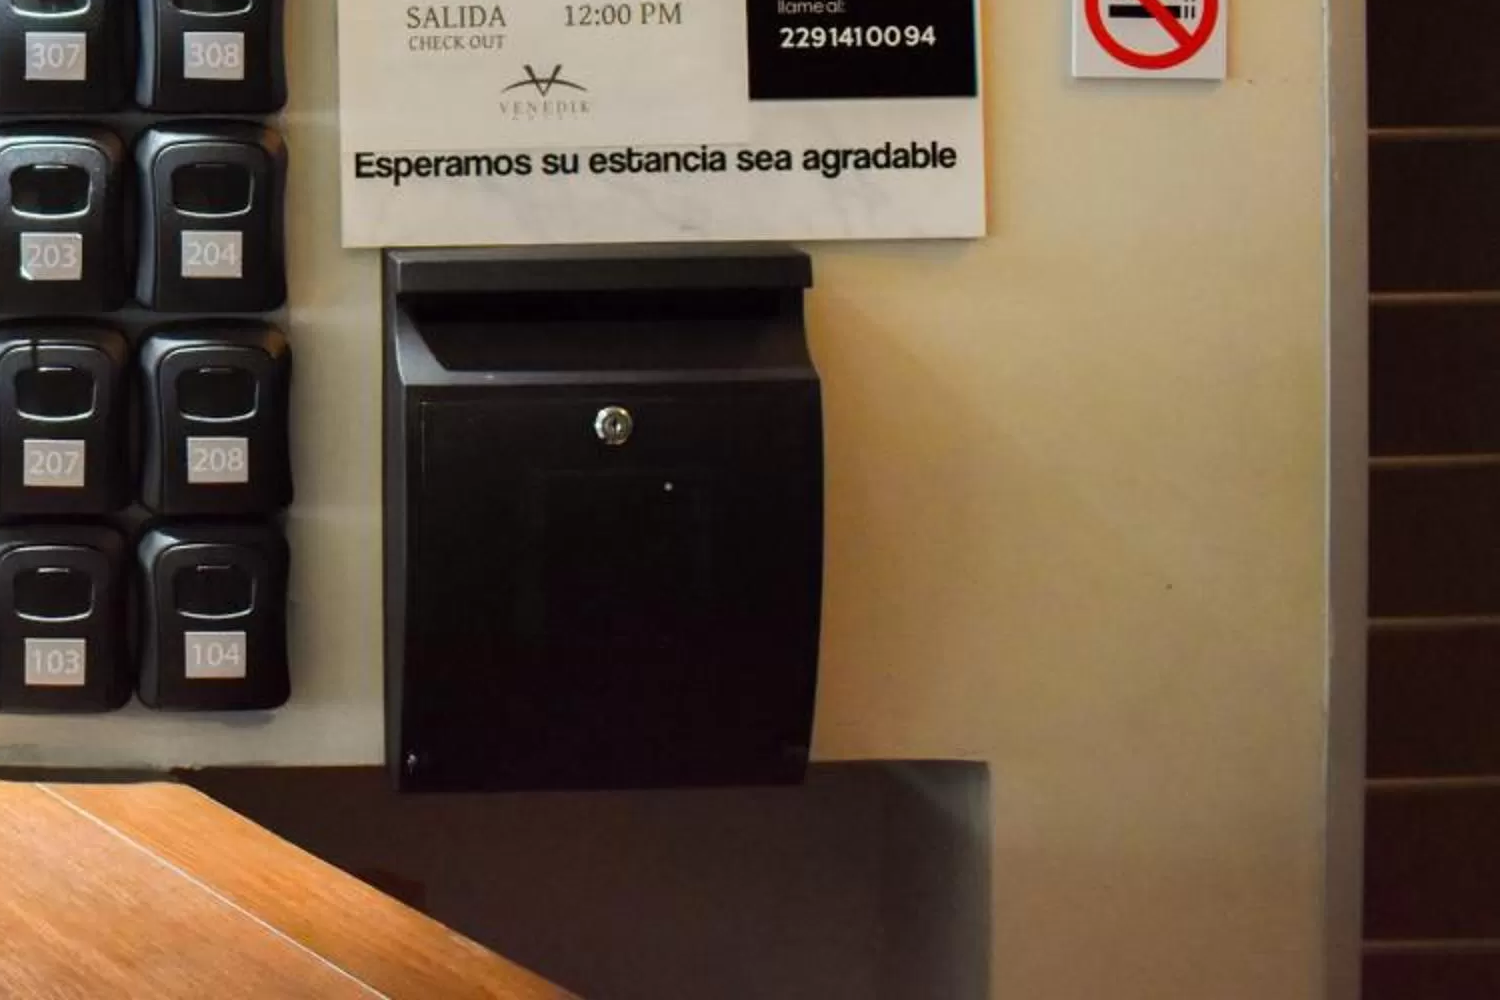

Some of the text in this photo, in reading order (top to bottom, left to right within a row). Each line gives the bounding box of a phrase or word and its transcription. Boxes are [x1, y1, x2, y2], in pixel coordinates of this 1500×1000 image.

[406, 2, 682, 29] SALIDA 12:00 PM
[777, 0, 825, 14] llame
[408, 34, 507, 51] CHECK OUT
[779, 25, 936, 48] 2291410094
[32, 42, 81, 69] 307
[189, 41, 240, 68] 308
[499, 101, 591, 114] VENEDIK
[354, 142, 957, 186] Esperamos su estancia sea agradable
[27, 244, 77, 269] 203
[187, 241, 236, 267] 204
[30, 450, 79, 475] 207
[192, 447, 244, 472] 208
[34, 649, 80, 675] 103
[192, 642, 240, 667] 104
